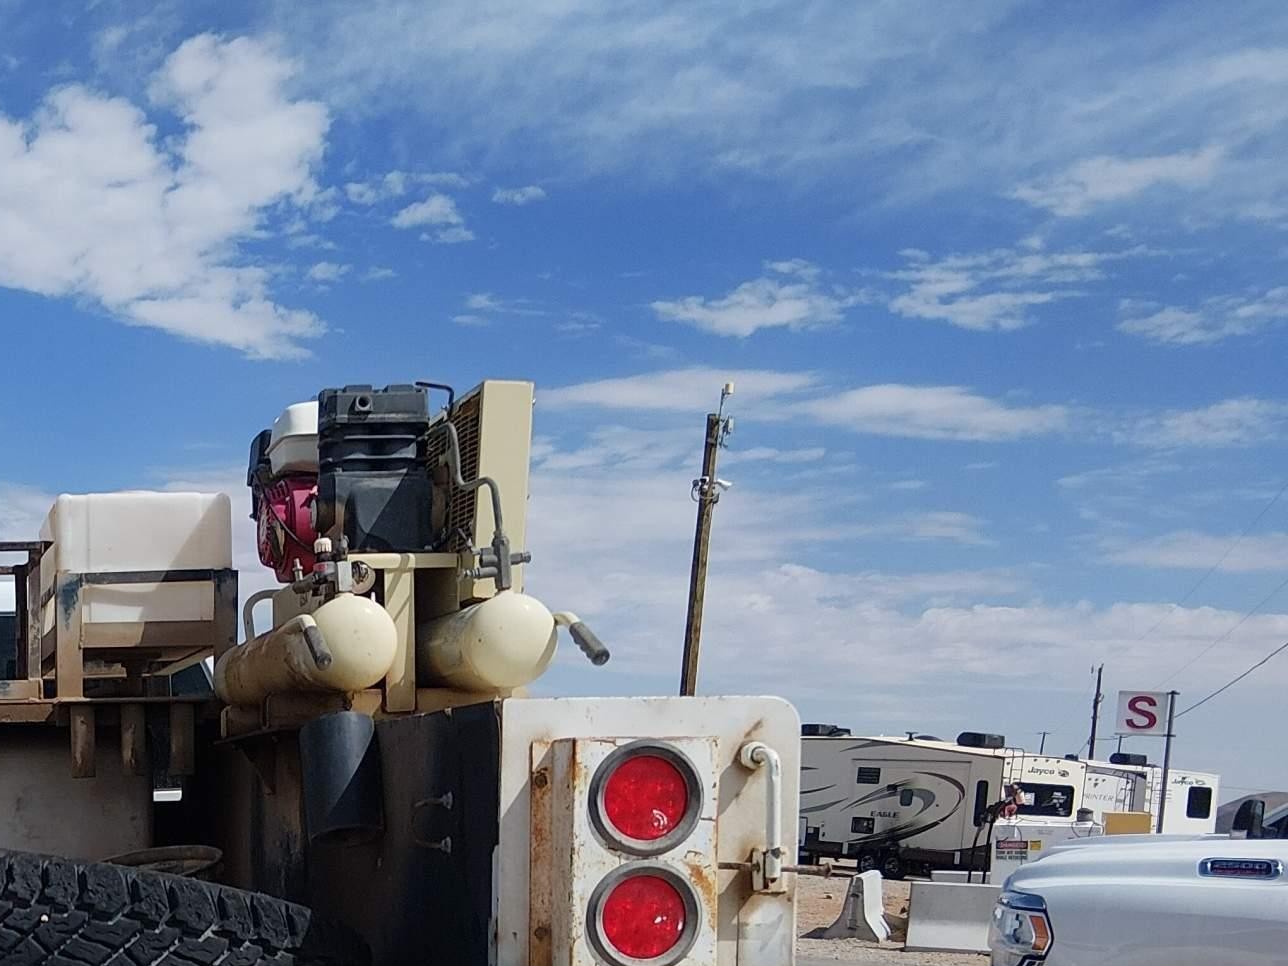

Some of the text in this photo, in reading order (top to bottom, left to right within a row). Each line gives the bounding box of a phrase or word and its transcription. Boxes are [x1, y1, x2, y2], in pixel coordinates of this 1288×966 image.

[1125, 695, 1157, 729] S
[1028, 766, 1055, 775] Jayco
[870, 810, 900, 818] EAGLE
